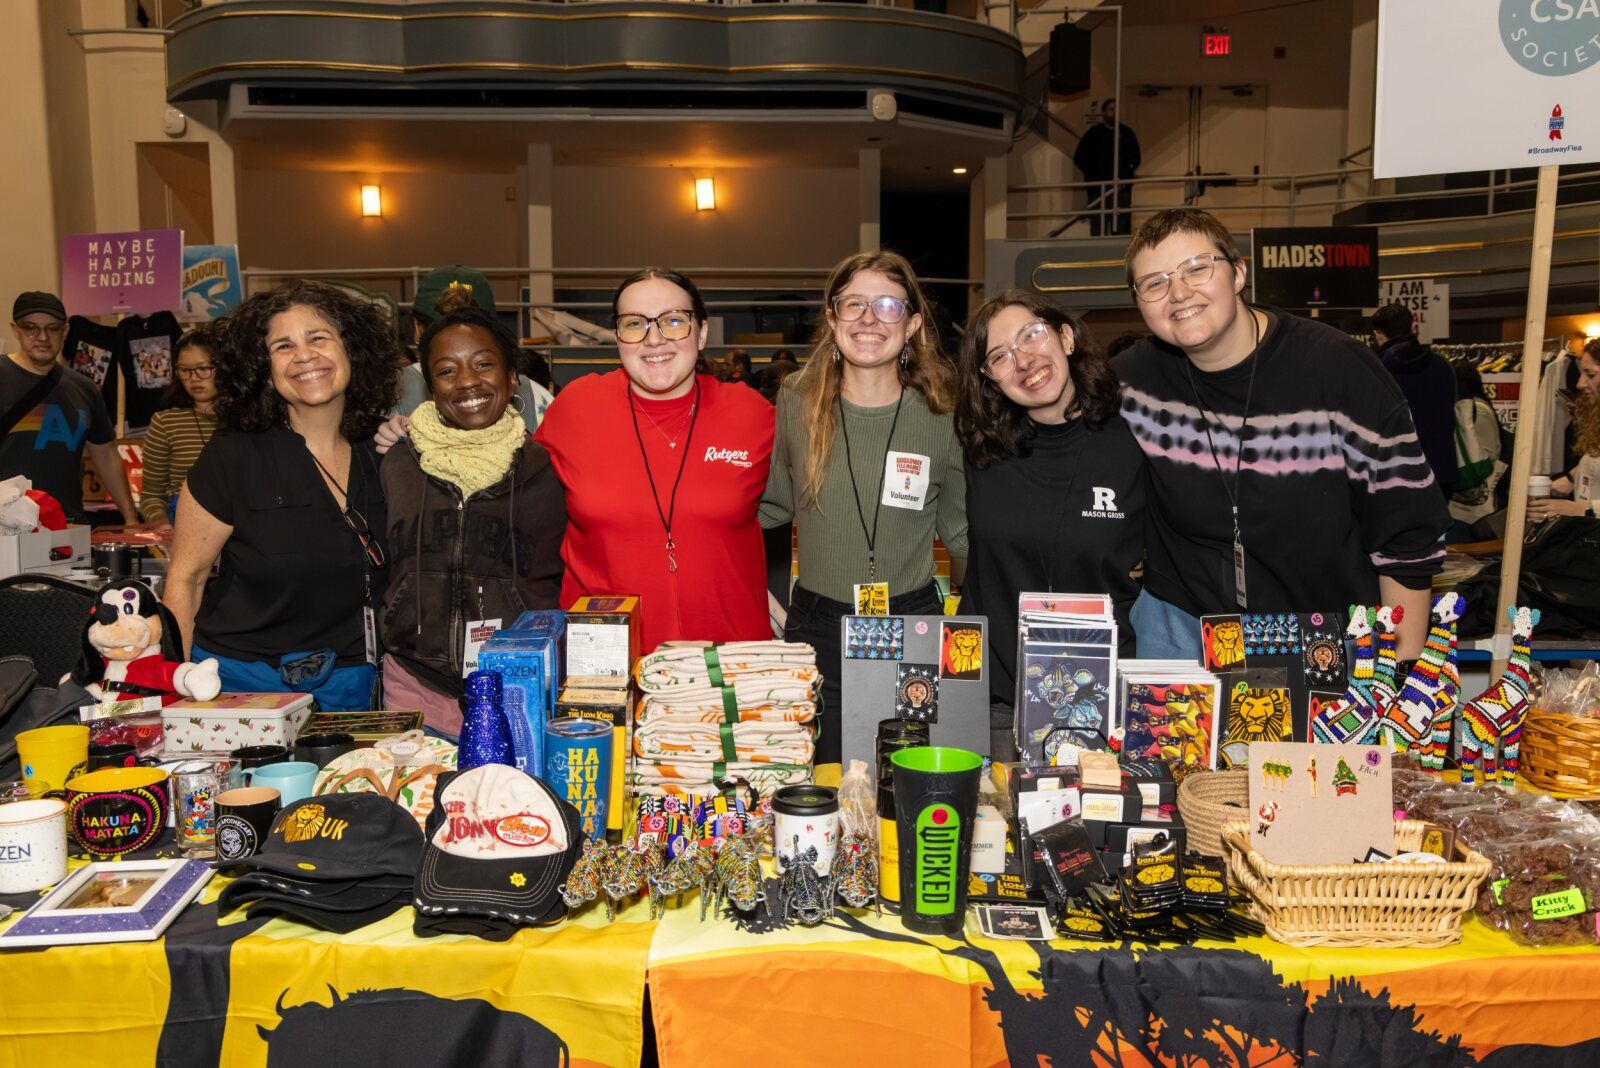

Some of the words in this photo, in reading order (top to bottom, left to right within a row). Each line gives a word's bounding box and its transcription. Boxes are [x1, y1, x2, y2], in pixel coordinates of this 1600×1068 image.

[1206, 36, 1230, 55] EXIT
[1528, 145, 1582, 154] #BroadwayFlea
[88, 238, 155, 255] MAYBE
[1262, 244, 1371, 268] HADESTOWN
[88, 255, 155, 271] HAPPY
[88, 271, 155, 288] ENDING
[1388, 282, 1394, 296] I
[1399, 281, 1424, 296] AM
[704, 446, 748, 463] Rutgers
[890, 491, 920, 502] Volunteer
[1092, 486, 1118, 511] R
[872, 597, 886, 606] LION
[871, 607, 887, 616] KING
[580, 711, 596, 719] LION
[597, 711, 614, 719] KING
[1367, 752, 1379, 764] $4
[1359, 765, 1379, 777] EACH
[1062, 805, 1071, 816] $5
[81, 812, 141, 827] HAKUNA
[84, 826, 140, 839] MATATA
[221, 817, 254, 837] APOTHECARY
[320, 817, 349, 841] UK
[919, 825, 959, 904] WICKED
[1155, 853, 1175, 864] KING
[1000, 874, 1021, 882] THE
[997, 880, 1025, 891] LION
[998, 888, 1028, 899] KING
[1535, 895, 1569, 907] Kitty
[1533, 904, 1576, 916] Crack
